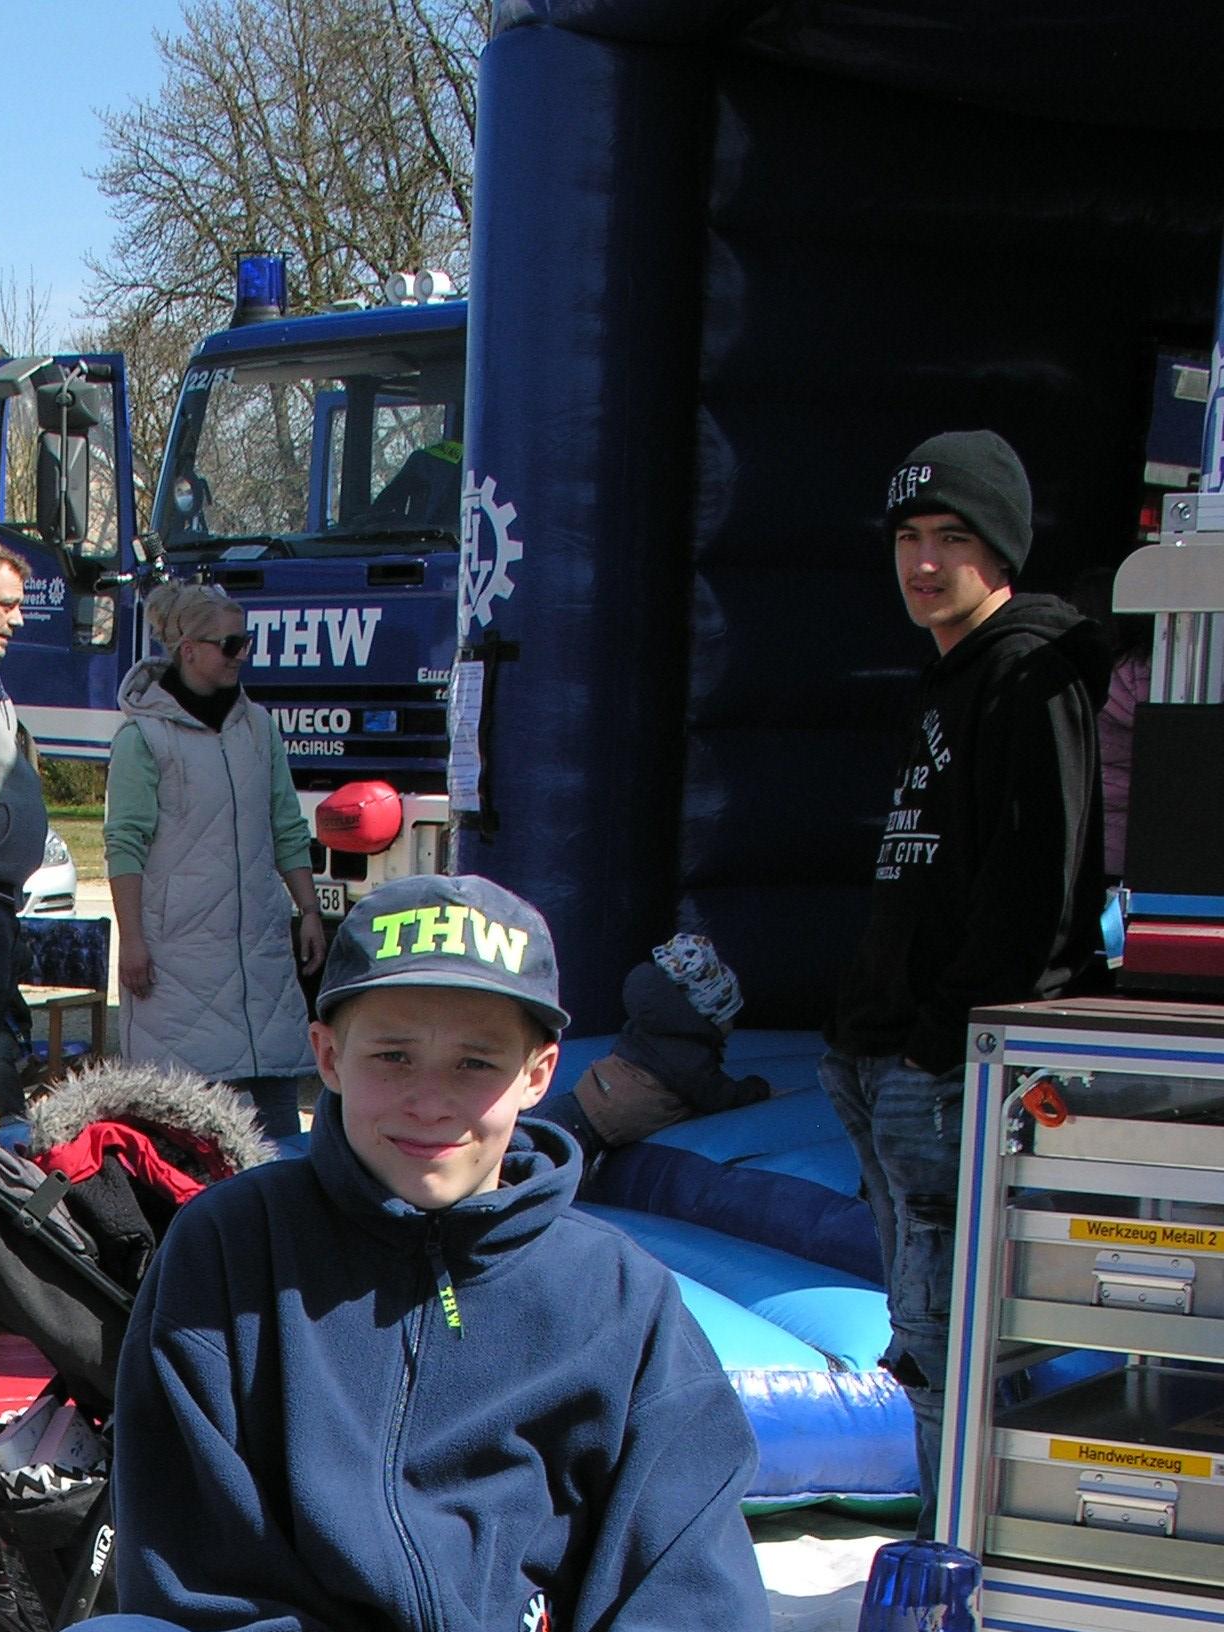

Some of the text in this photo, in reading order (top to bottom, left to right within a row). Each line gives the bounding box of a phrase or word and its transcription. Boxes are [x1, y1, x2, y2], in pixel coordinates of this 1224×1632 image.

[24, 577, 47, 590] ches
[247, 607, 382, 667] THW
[272, 708, 351, 734] IVECO
[895, 841, 939, 865] CITY
[372, 905, 528, 974] THW
[1087, 1221, 1217, 1246] Werkzeug Metall 2
[439, 1286, 461, 1328] THW
[1078, 1445, 1182, 1474] Handwerkzeug
